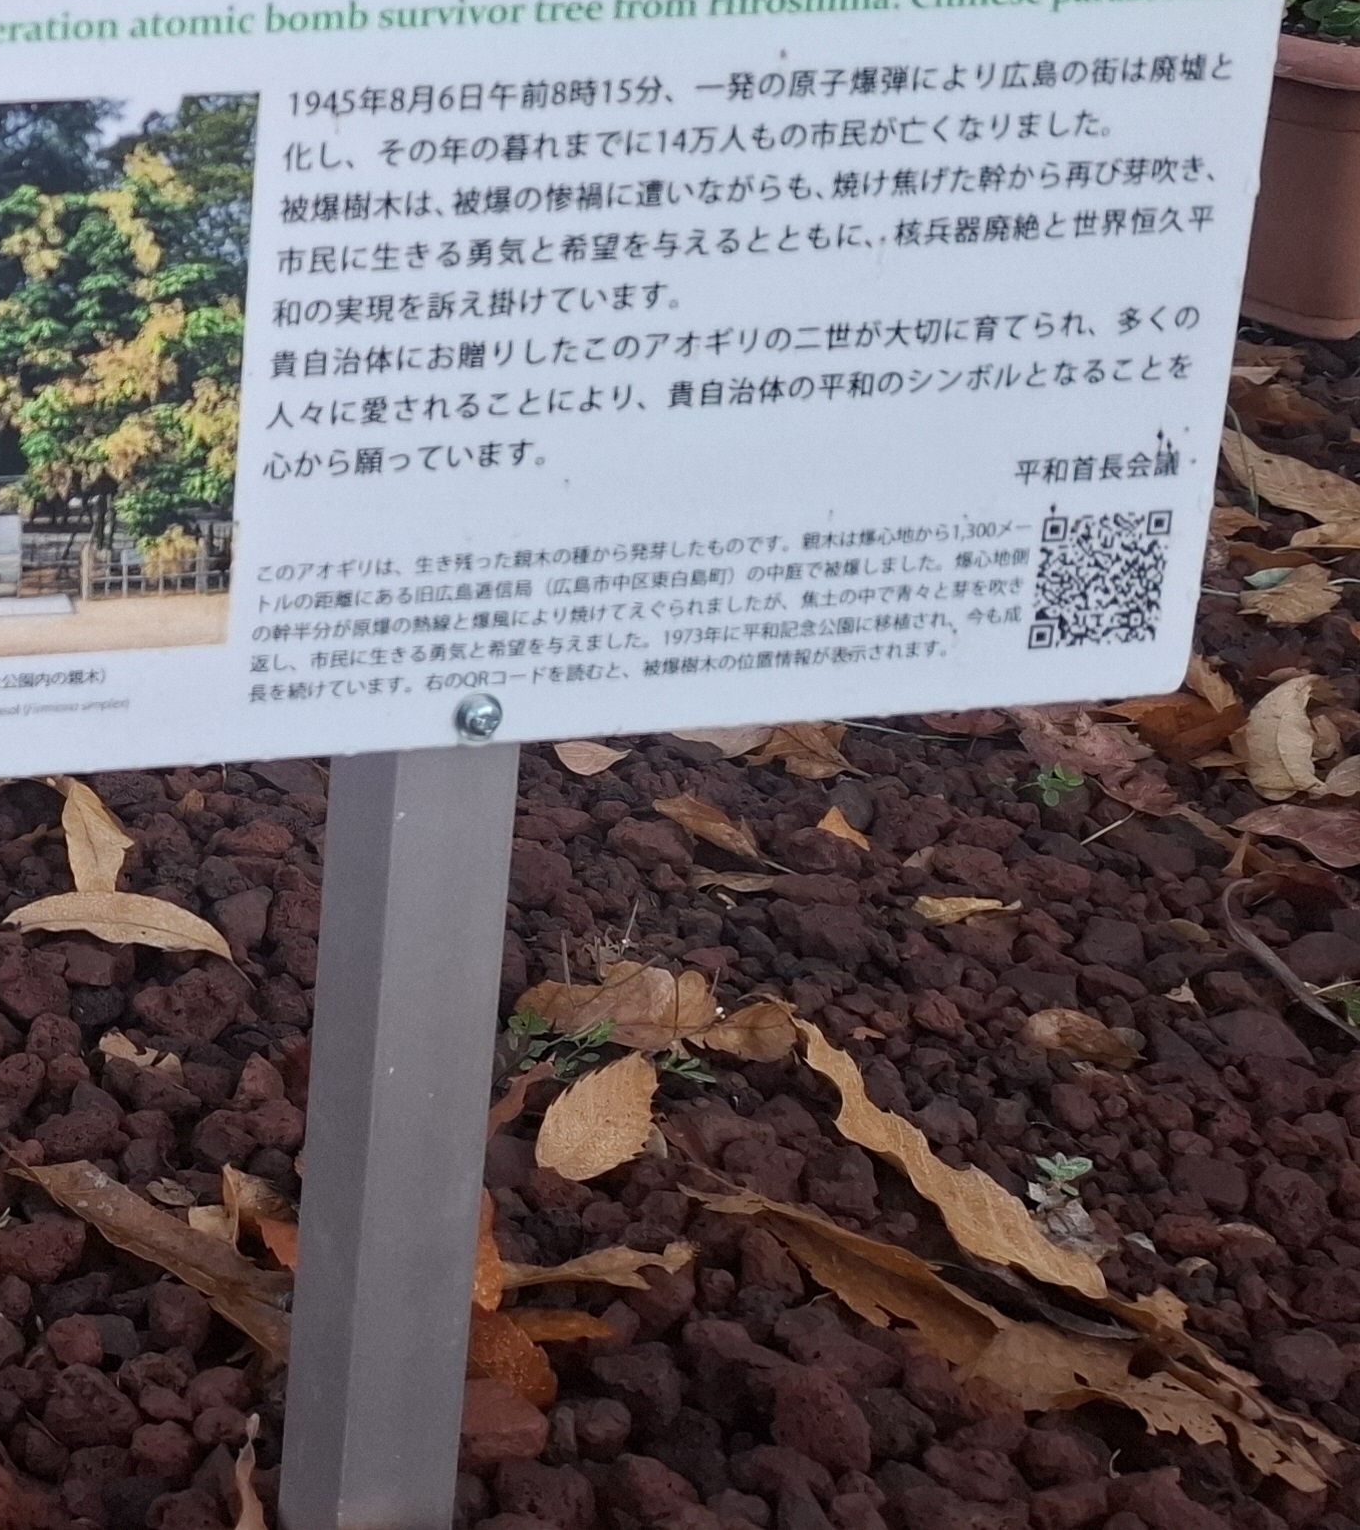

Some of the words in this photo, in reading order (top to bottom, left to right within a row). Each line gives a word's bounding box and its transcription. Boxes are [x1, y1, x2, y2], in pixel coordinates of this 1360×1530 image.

[129, 5, 255, 40] atomic
[266, 0, 369, 35] bomb
[288, 53, 1233, 117] 1945年8月6日午前8時15分、一発の原子爆弾により広島の街は廃墟と
[283, 108, 1110, 172] 化し、その年の暮れまでに14万人もの市民が亡くなりました。
[279, 155, 1216, 224] 被爆樹木は、被爆の惨禍に遭いながらも、焼け焦げた幹から再び芽吹き、
[276, 205, 1215, 276] 市民に生きる勇気と希望を与えるとともに、核兵器廃絶と世界恒久平
[272, 281, 680, 328] 和の実現を訴え掛けています。
[269, 304, 1201, 379] 貴自治体にお贈りしたこのアオギリの二世が大切に育てられ、多くの
[265, 353, 1192, 431] 人々に愛されることにより、貴自治体の平和のシンボルとなることを
[262, 439, 548, 481] 心から願っています。
[1014, 451, 1181, 487] 平和首長会議
